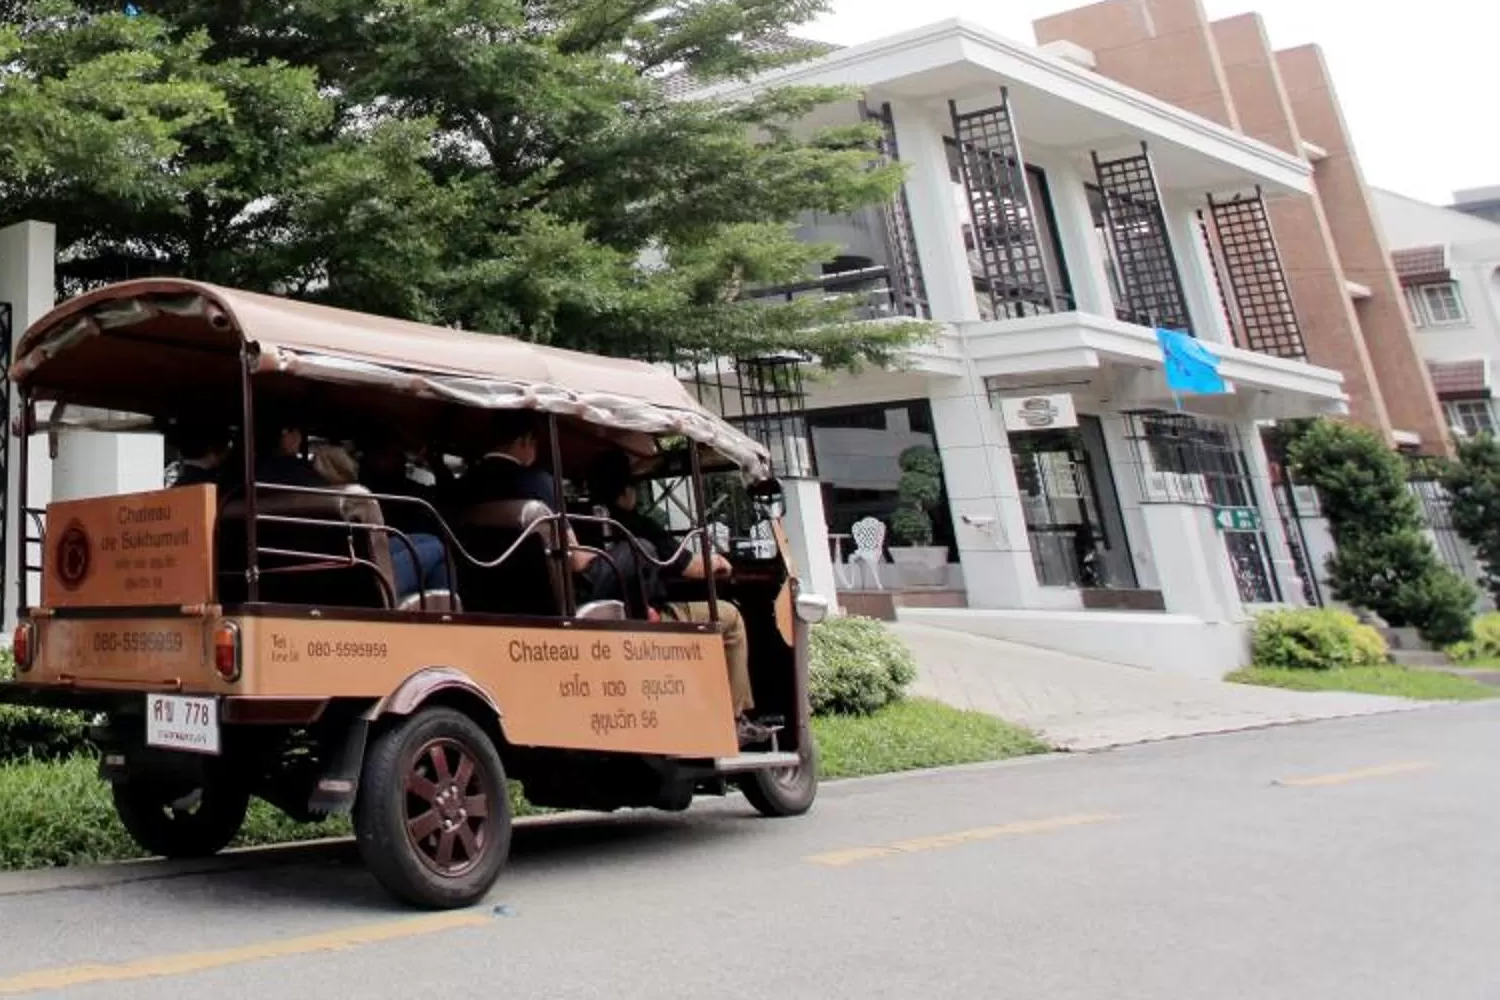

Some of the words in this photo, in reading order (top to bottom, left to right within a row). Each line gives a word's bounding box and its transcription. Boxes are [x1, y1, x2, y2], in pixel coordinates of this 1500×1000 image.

[509, 640, 579, 662] Chateau
[591, 640, 612, 660] de
[623, 640, 703, 661] Sukhumvit
[185, 702, 209, 726] 778
